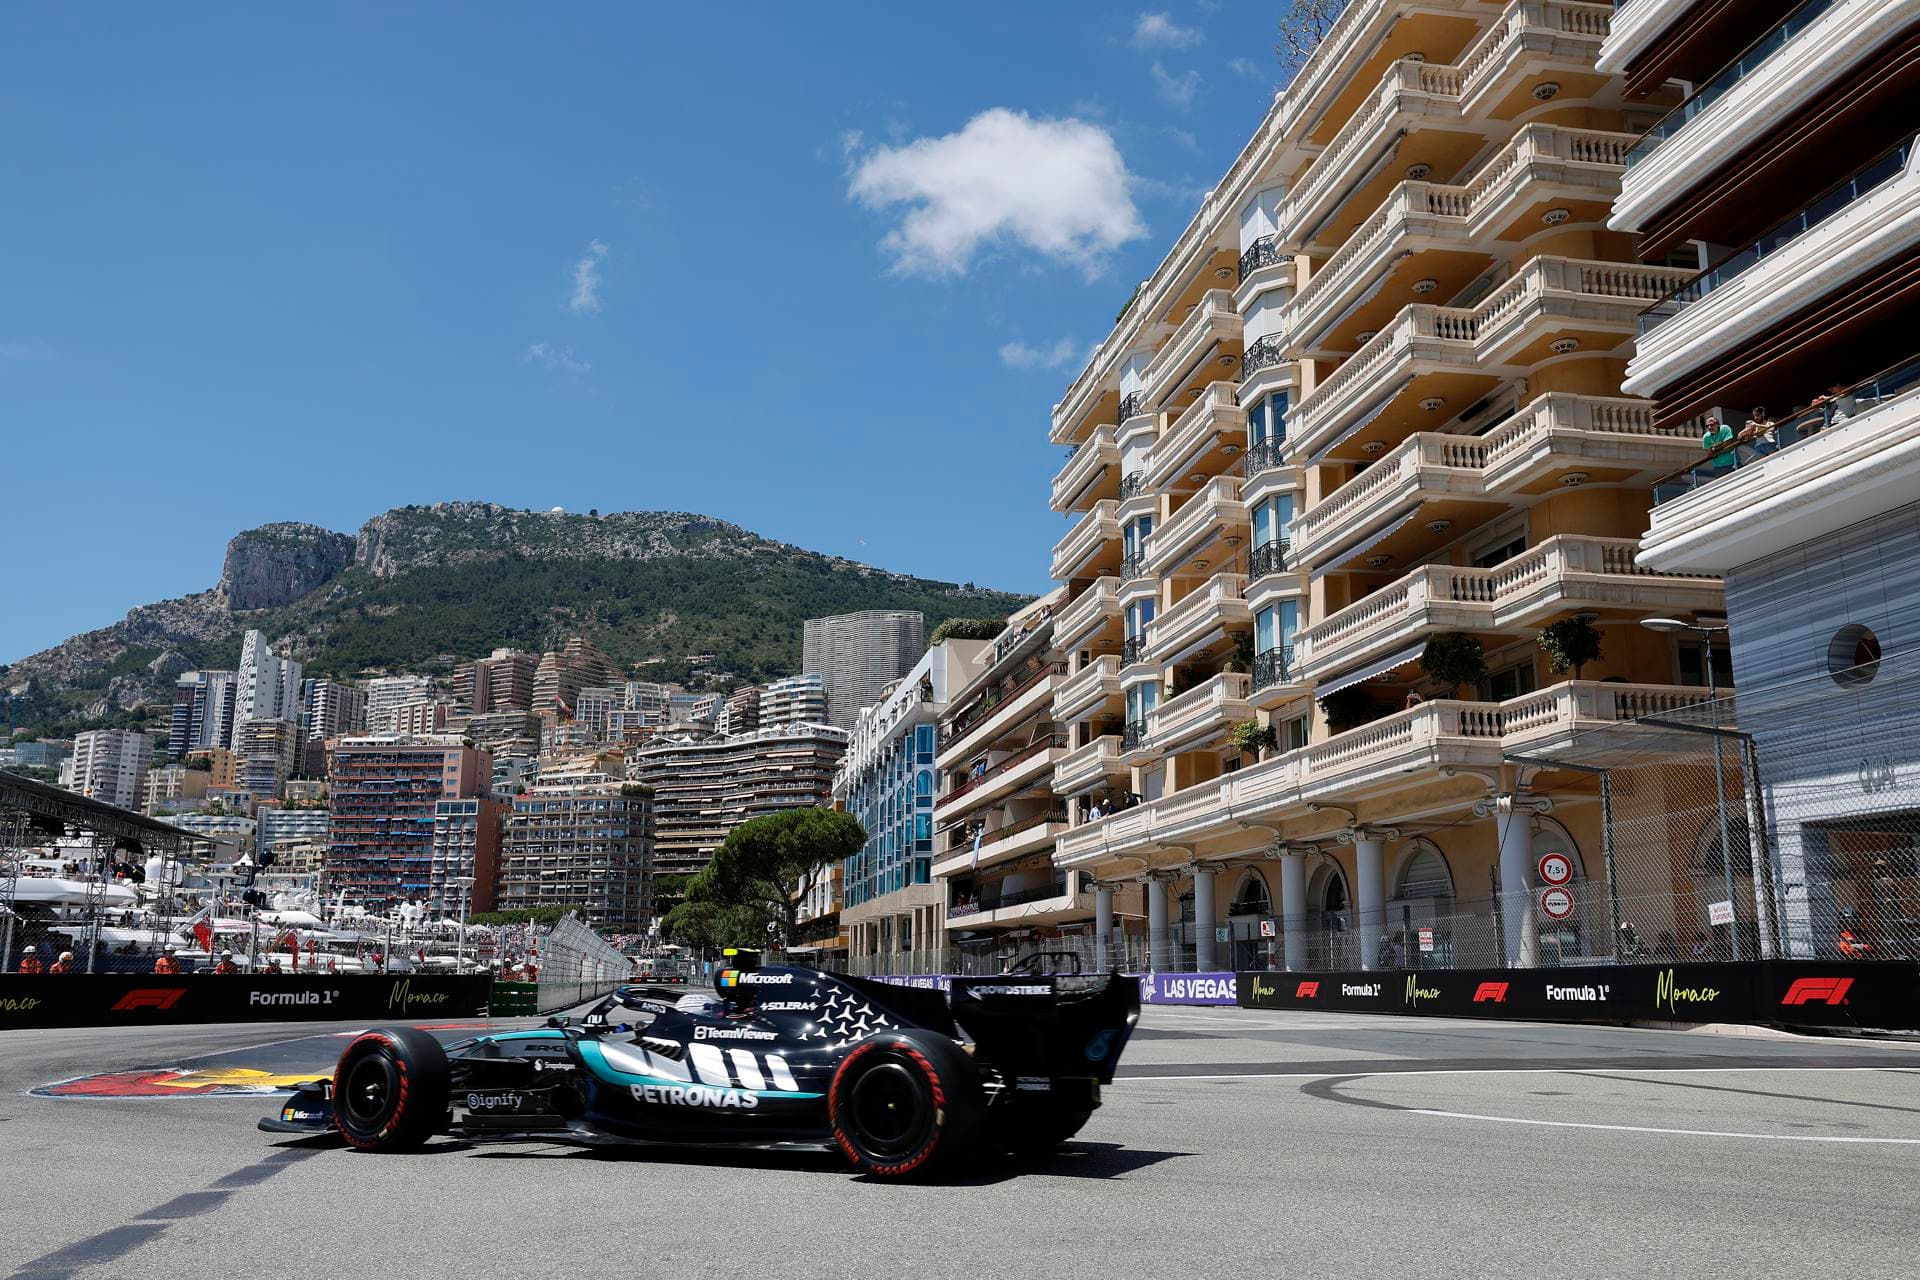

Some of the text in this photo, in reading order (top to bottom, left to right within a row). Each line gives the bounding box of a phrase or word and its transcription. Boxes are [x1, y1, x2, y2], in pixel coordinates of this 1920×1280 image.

[739, 973, 793, 984] Microsoft
[250, 991, 320, 1005] Formula
[389, 979, 448, 1013] Monaco
[1164, 979, 1237, 999] LAS VEGAS
[1252, 976, 1276, 1003] Monaco
[1342, 984, 1372, 997] Formula
[1396, 974, 1441, 1009] Monaco
[1546, 985, 1596, 1001] Formula
[1657, 968, 1720, 1014] Monaco
[767, 1002, 811, 1011] SOLERA
[706, 1027, 778, 1041] TeamViewer
[630, 1084, 759, 1109] PETRONAS
